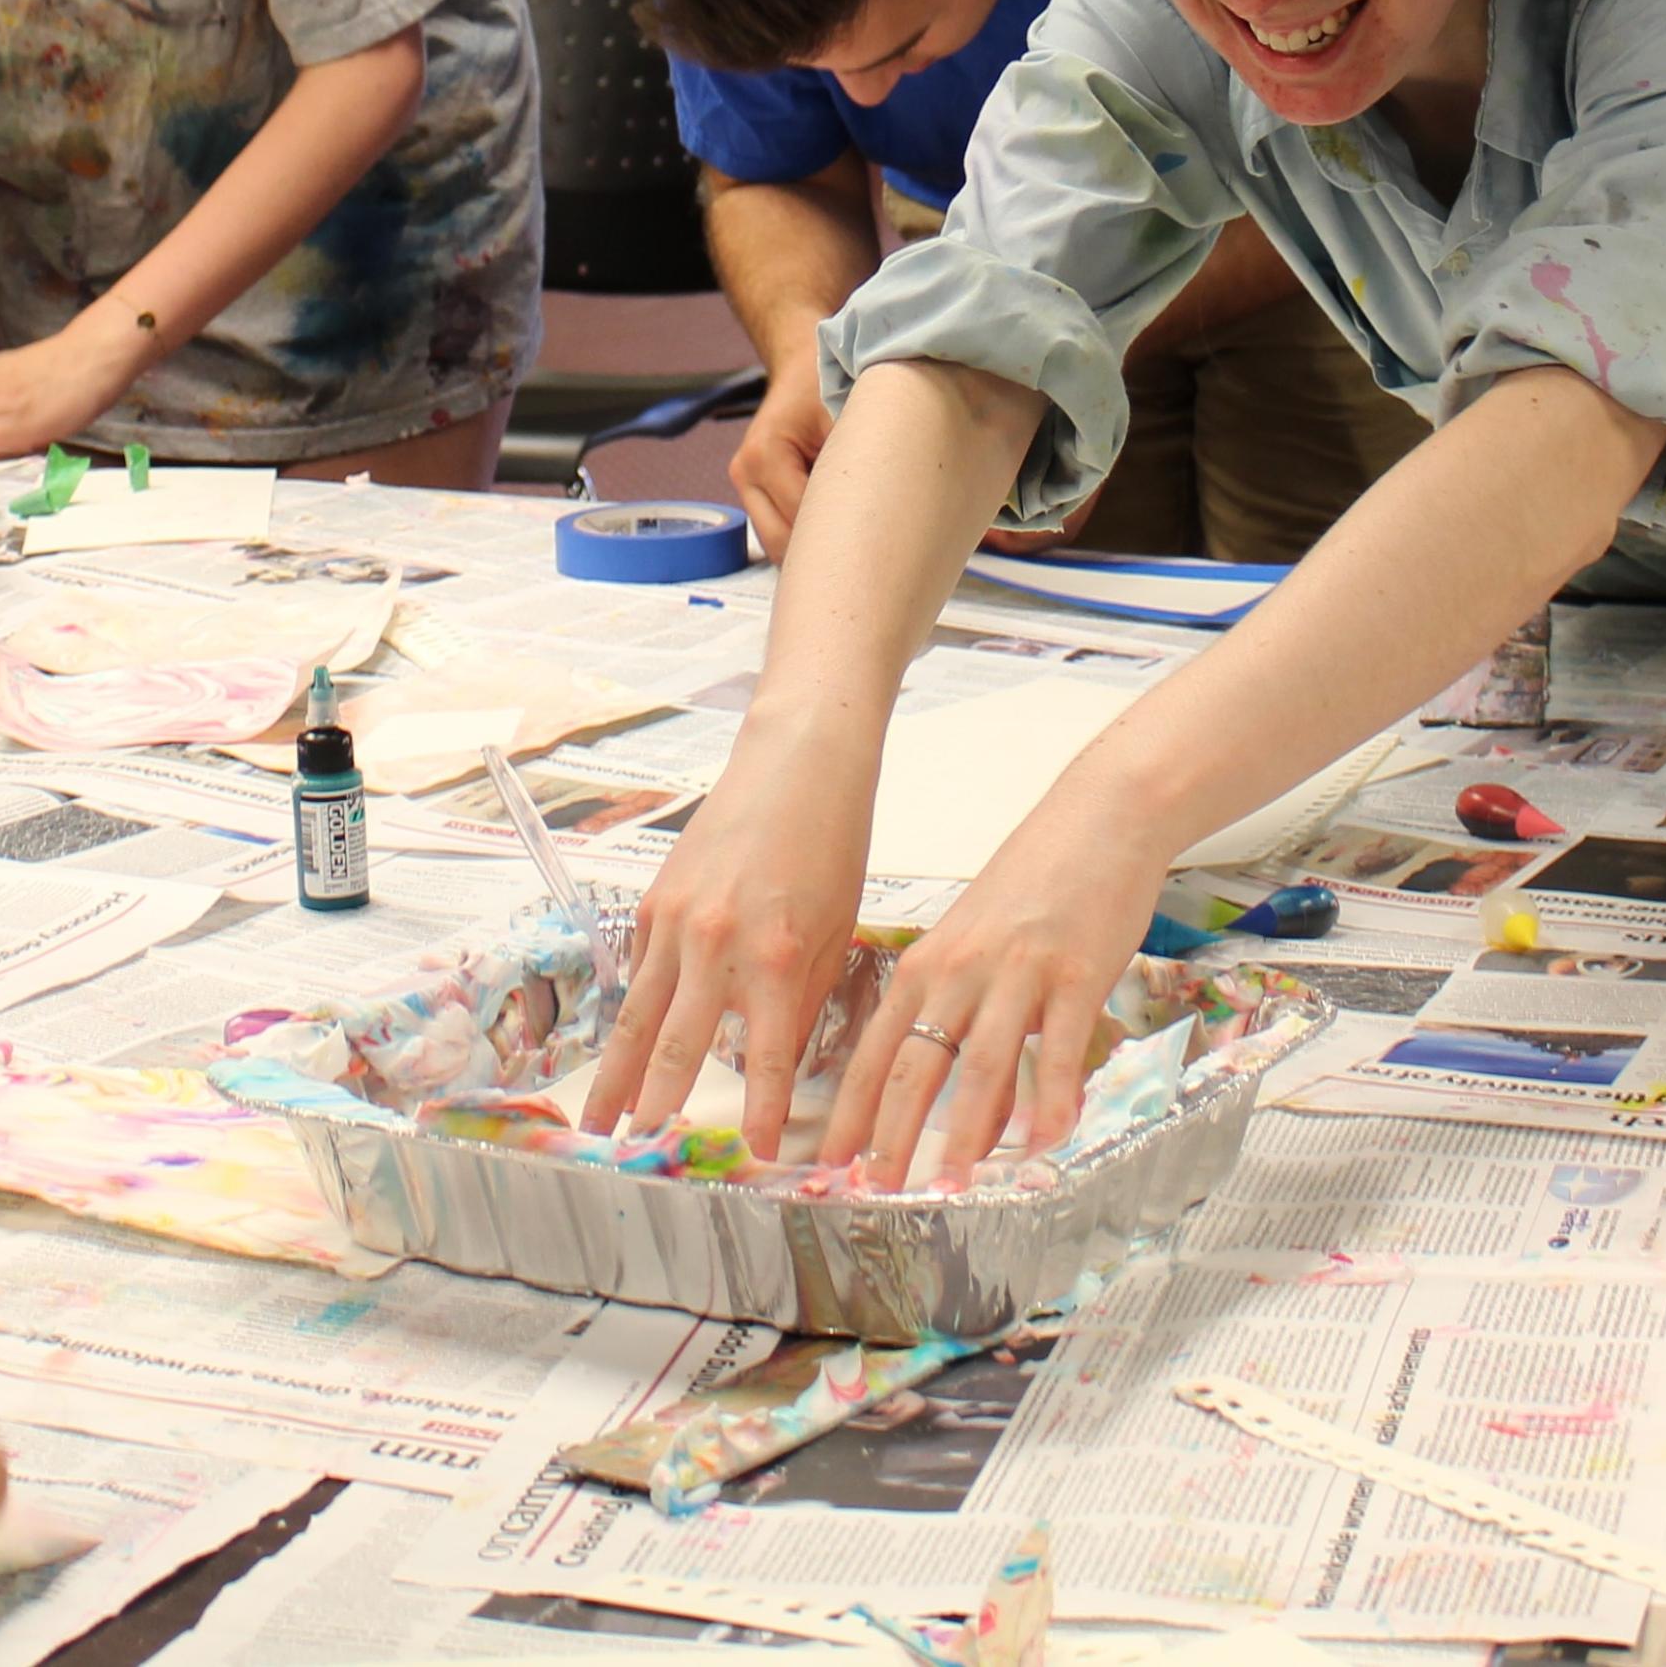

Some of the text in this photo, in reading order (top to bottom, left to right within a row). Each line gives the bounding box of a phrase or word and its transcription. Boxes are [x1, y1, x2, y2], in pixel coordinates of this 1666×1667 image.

[329, 803, 346, 880] GOLDEN
[1400, 1070, 1431, 1084] of
[1442, 1074, 1588, 1102] creativity
[1593, 1089, 1647, 1109] the
[554, 1496, 633, 1569] Creating
